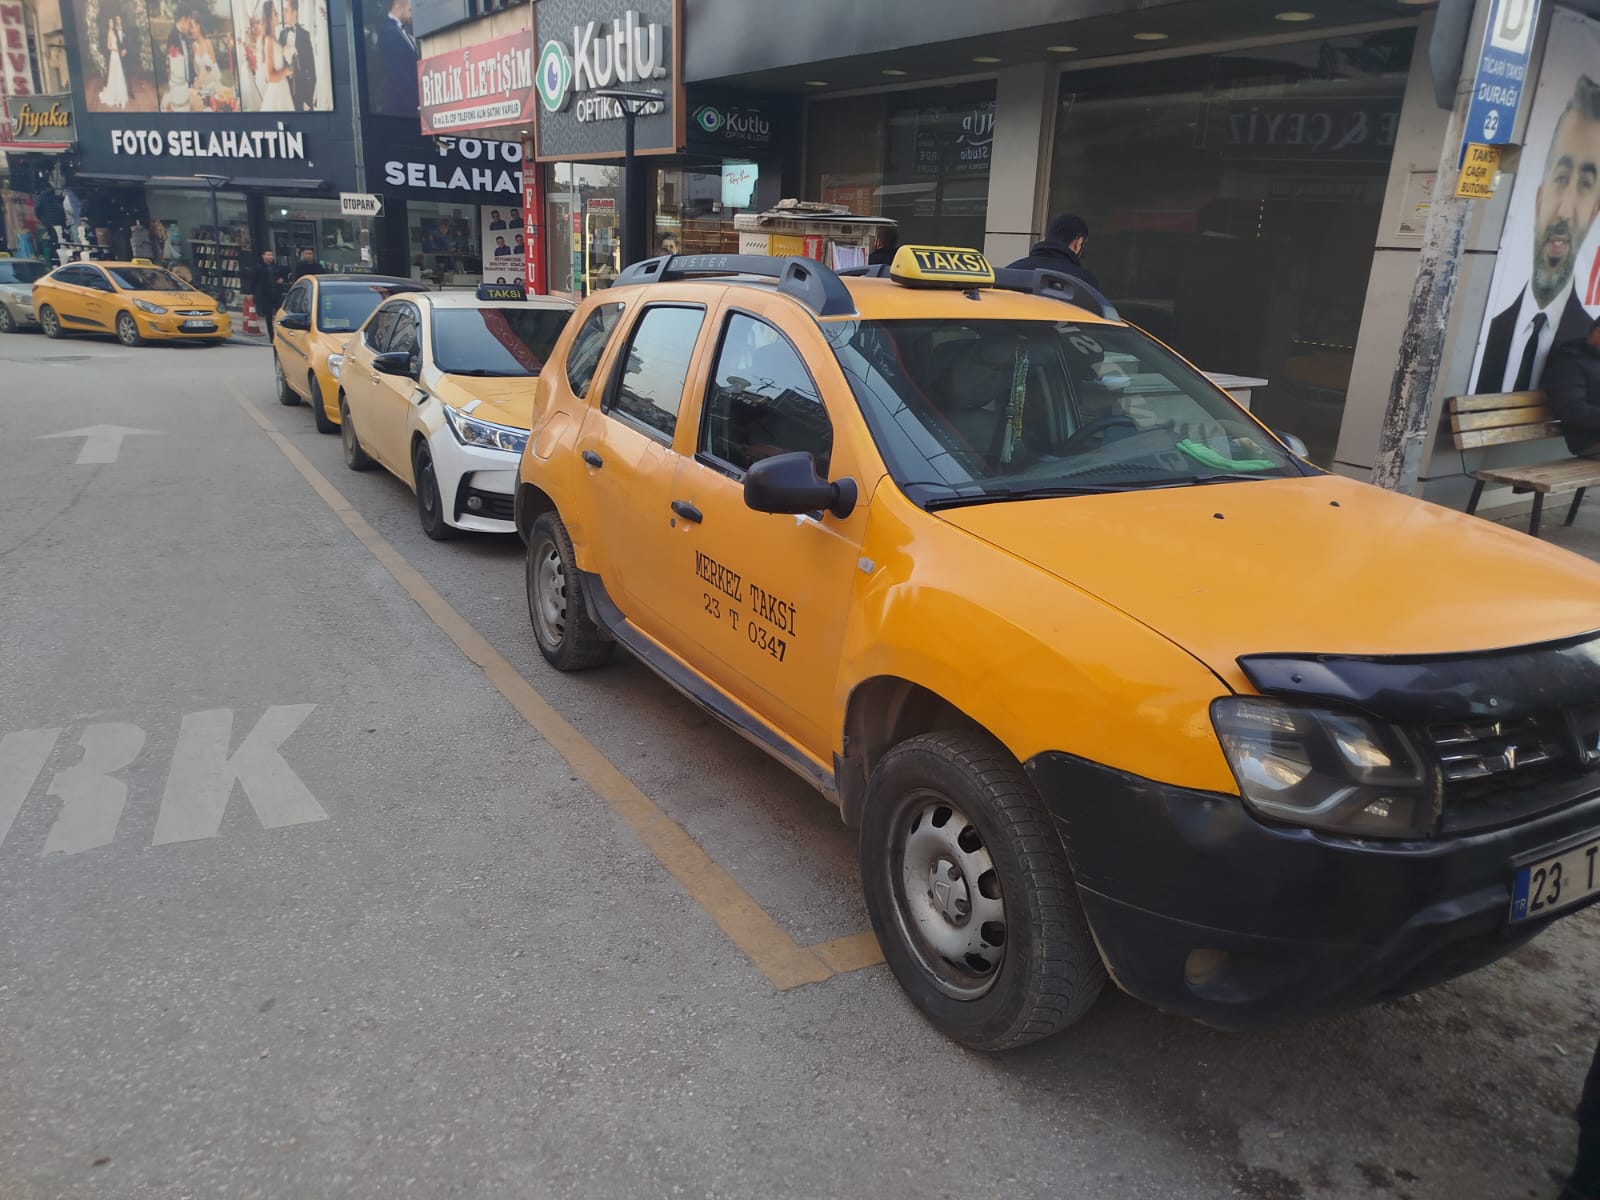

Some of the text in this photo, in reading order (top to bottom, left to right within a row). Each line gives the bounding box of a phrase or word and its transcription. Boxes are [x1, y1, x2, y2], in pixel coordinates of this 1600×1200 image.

[573, 10, 663, 92] Kutlu
[421, 48, 532, 107] BİRLİK İLETİŞİM
[1478, 83, 1518, 107] DURAĞI
[13, 102, 69, 136] fiyaka
[726, 112, 769, 134] Kutlu
[1485, 115, 1498, 130] 22
[111, 121, 305, 159] FOTO SELAHATTİN
[439, 136, 522, 163] FOTO
[343, 198, 376, 211] OTOPARK
[671, 257, 728, 268] DUSTER
[695, 549, 797, 637] MERKEZ TAKSİ
[703, 592, 787, 662] 23 T 0347
[1530, 846, 1598, 912] 23 T
[1514, 898, 1526, 910] TR
